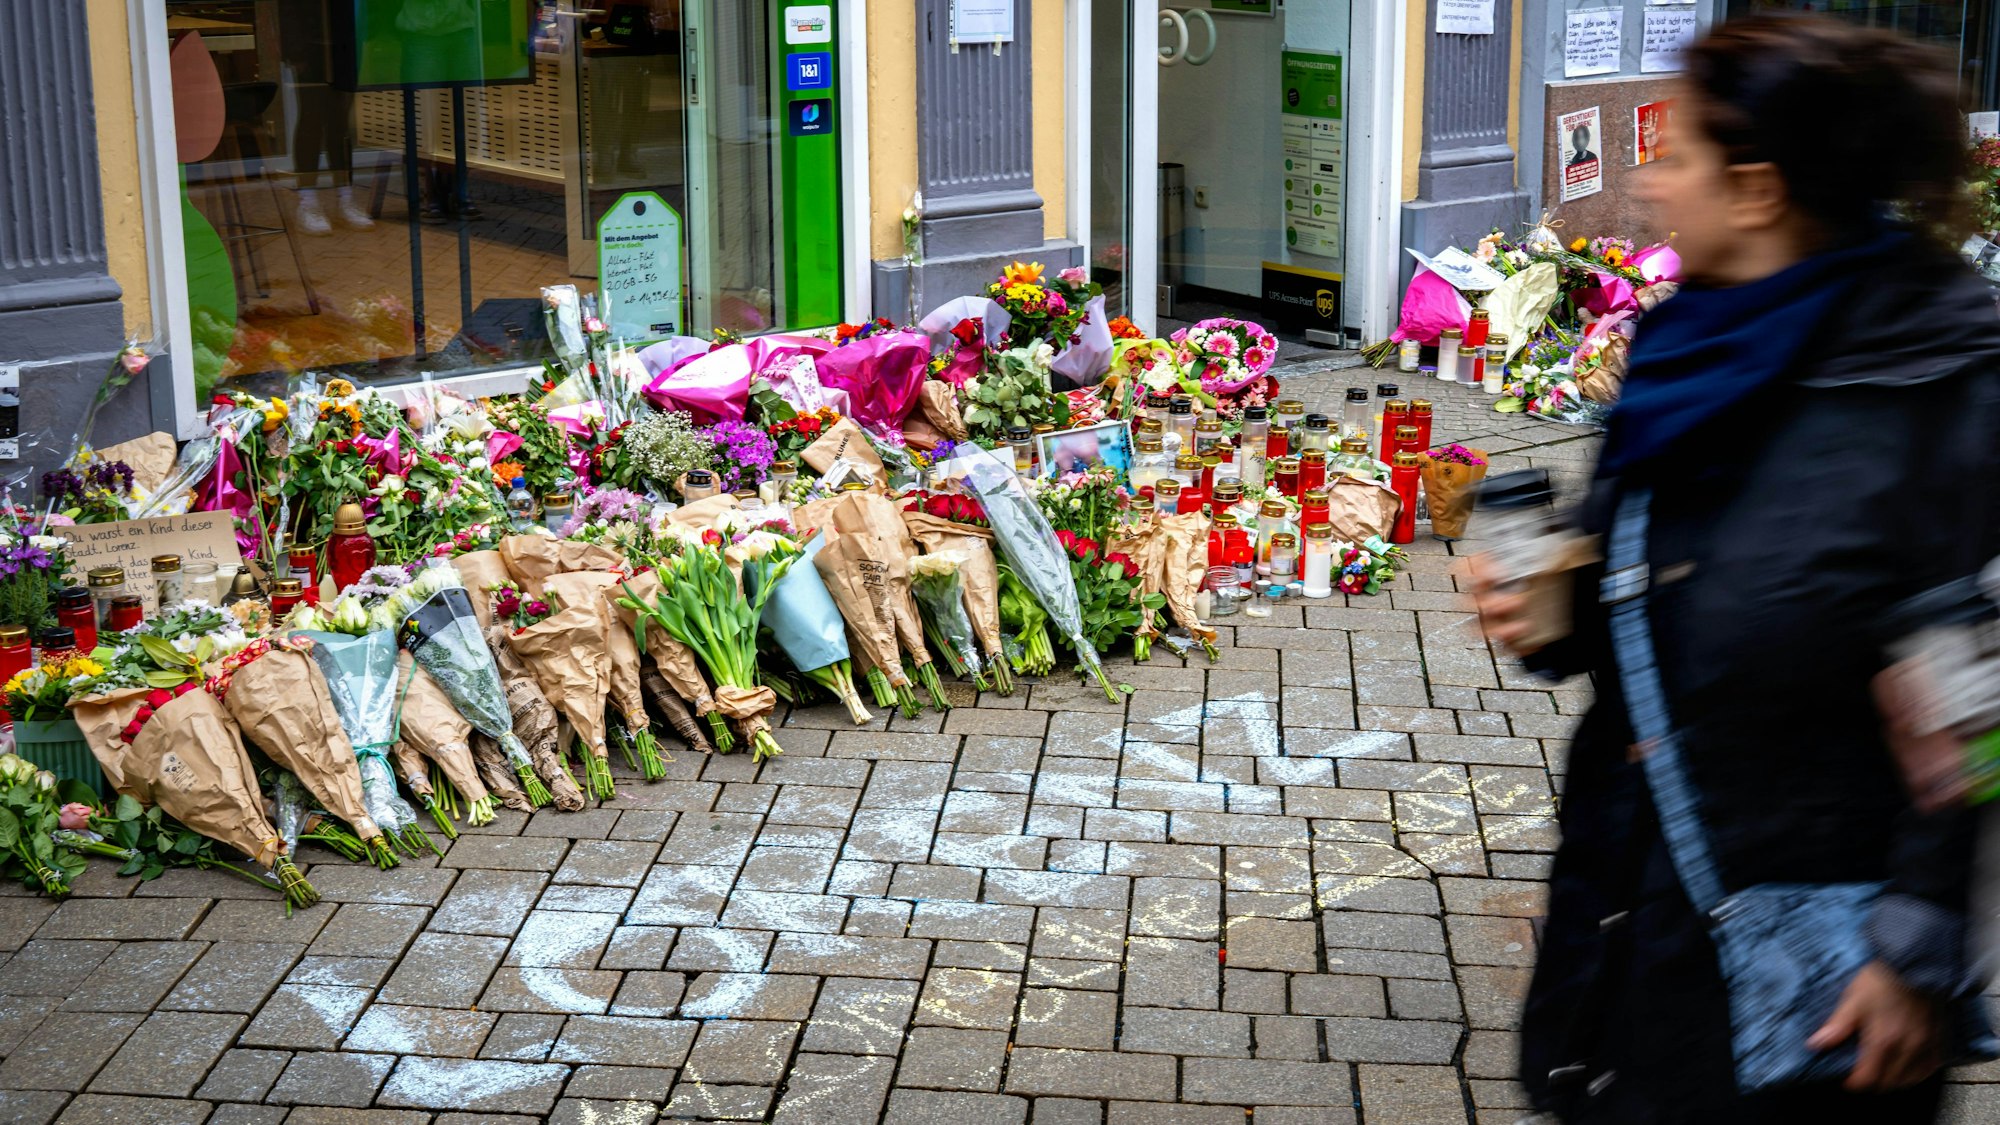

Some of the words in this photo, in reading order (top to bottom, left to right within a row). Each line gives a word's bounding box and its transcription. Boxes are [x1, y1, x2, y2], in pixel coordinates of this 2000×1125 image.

[800, 64, 819, 77] 1&1
[631, 233, 659, 241] Angebot
[1268, 290, 1281, 301] UPS
[1318, 297, 1333, 314] ups
[64, 531, 84, 544] Du
[88, 526, 124, 541] warst
[128, 526, 144, 536] ein
[149, 518, 175, 535] Kind
[181, 518, 214, 532] dieser
[130, 555, 149, 568] das
[278, 690, 1408, 1108] LORENZ
